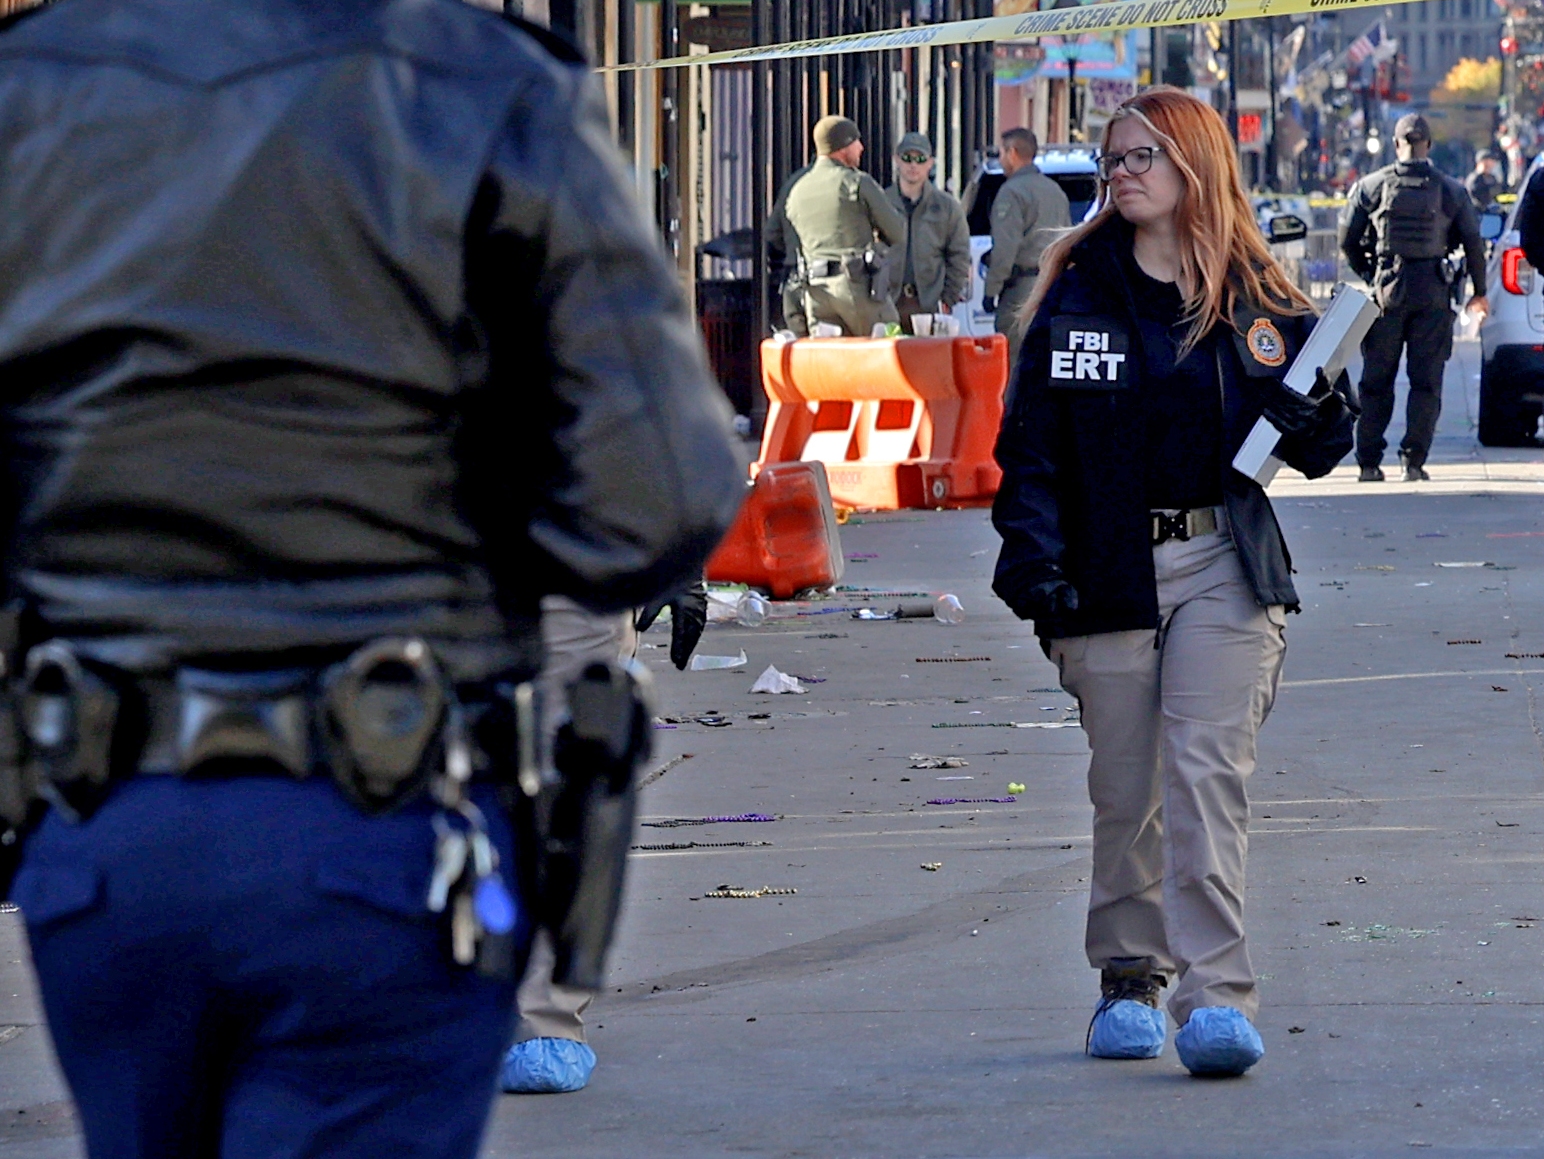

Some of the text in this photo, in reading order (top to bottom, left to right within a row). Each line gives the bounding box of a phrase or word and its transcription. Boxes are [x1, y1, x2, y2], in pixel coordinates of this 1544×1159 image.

[1014, 11, 1068, 35] CRIME
[1065, 5, 1122, 31] SCENE
[1116, 2, 1146, 27] DO
[1069, 330, 1110, 352] FBI
[1051, 350, 1126, 382] ERT
